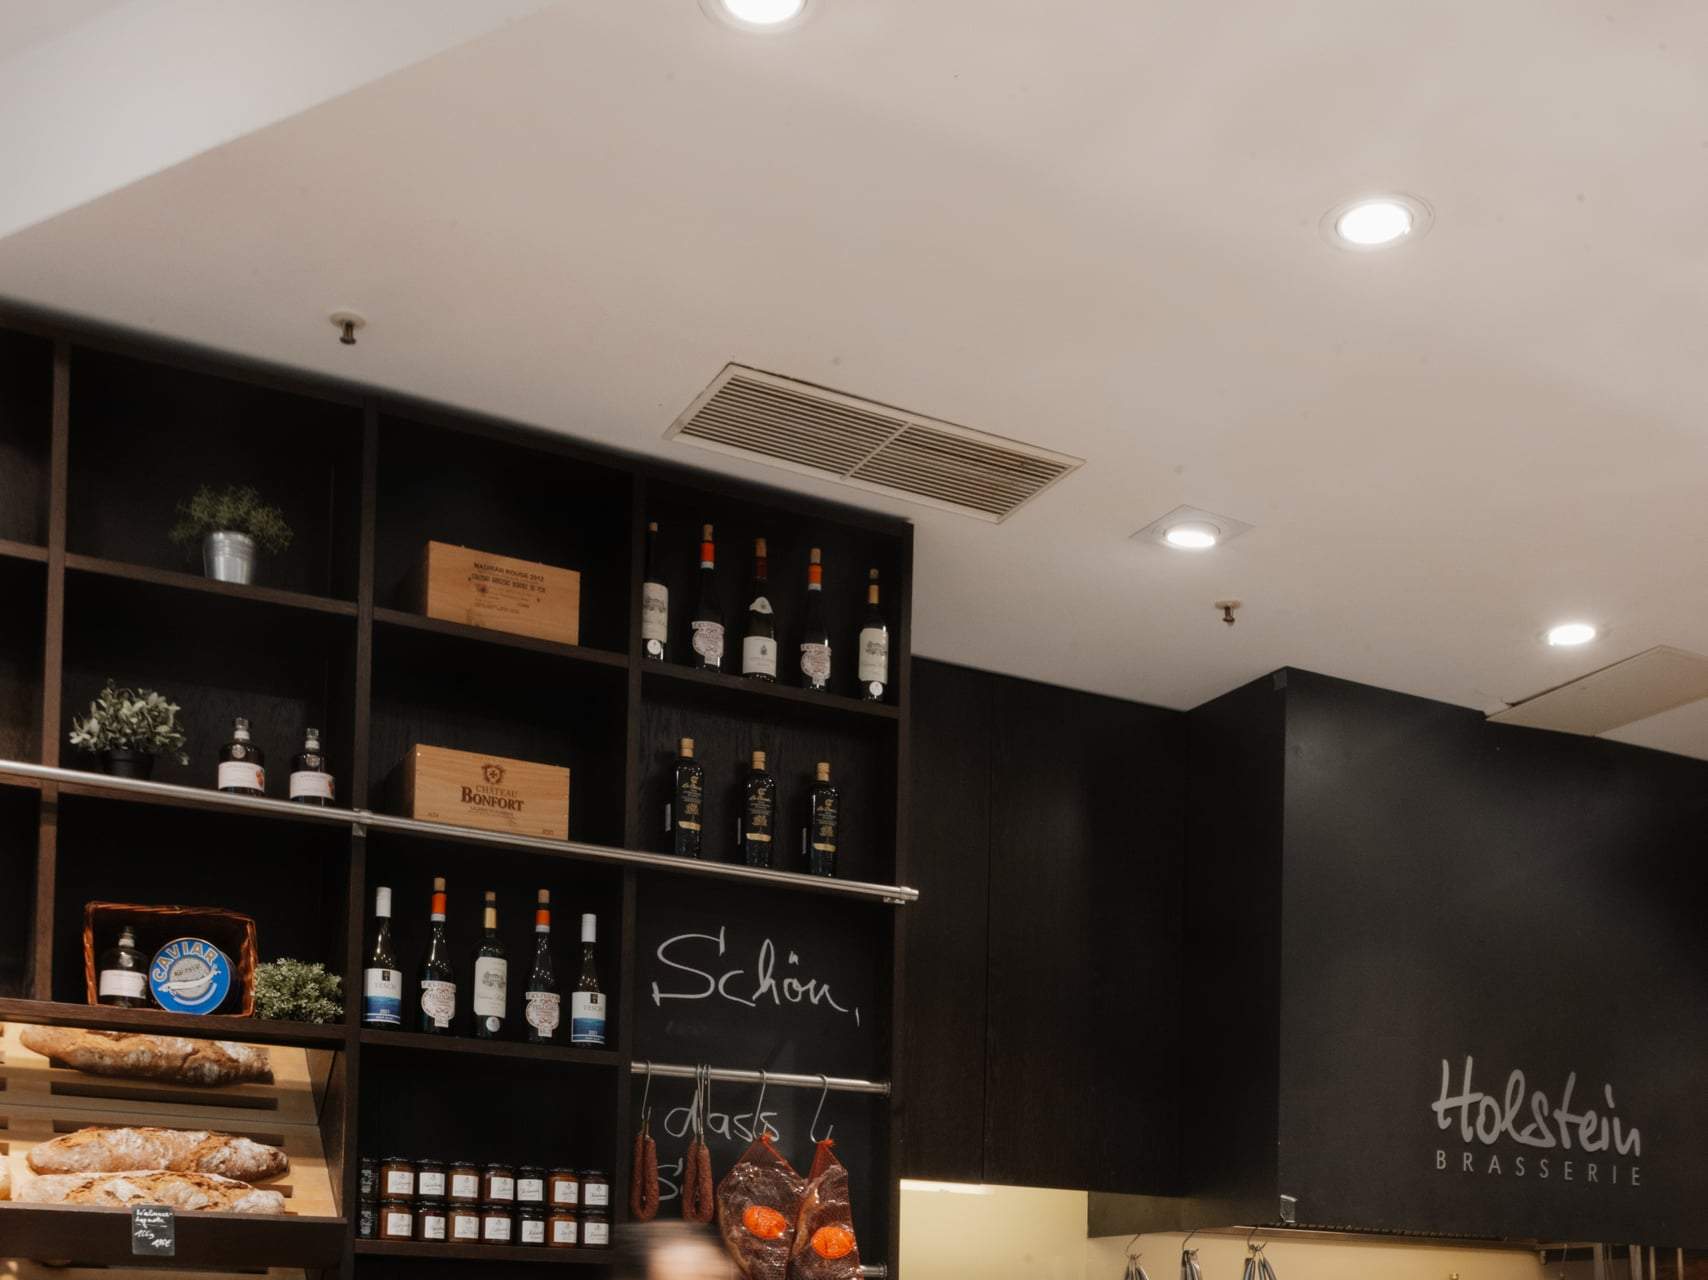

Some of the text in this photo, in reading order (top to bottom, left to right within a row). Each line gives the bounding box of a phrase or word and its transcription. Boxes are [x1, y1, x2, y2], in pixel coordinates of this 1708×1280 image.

[152, 941, 219, 983] CAVIAR
[1431, 1055, 1642, 1157] Holstein
[1436, 1149, 1641, 1186] BRASSERIE
